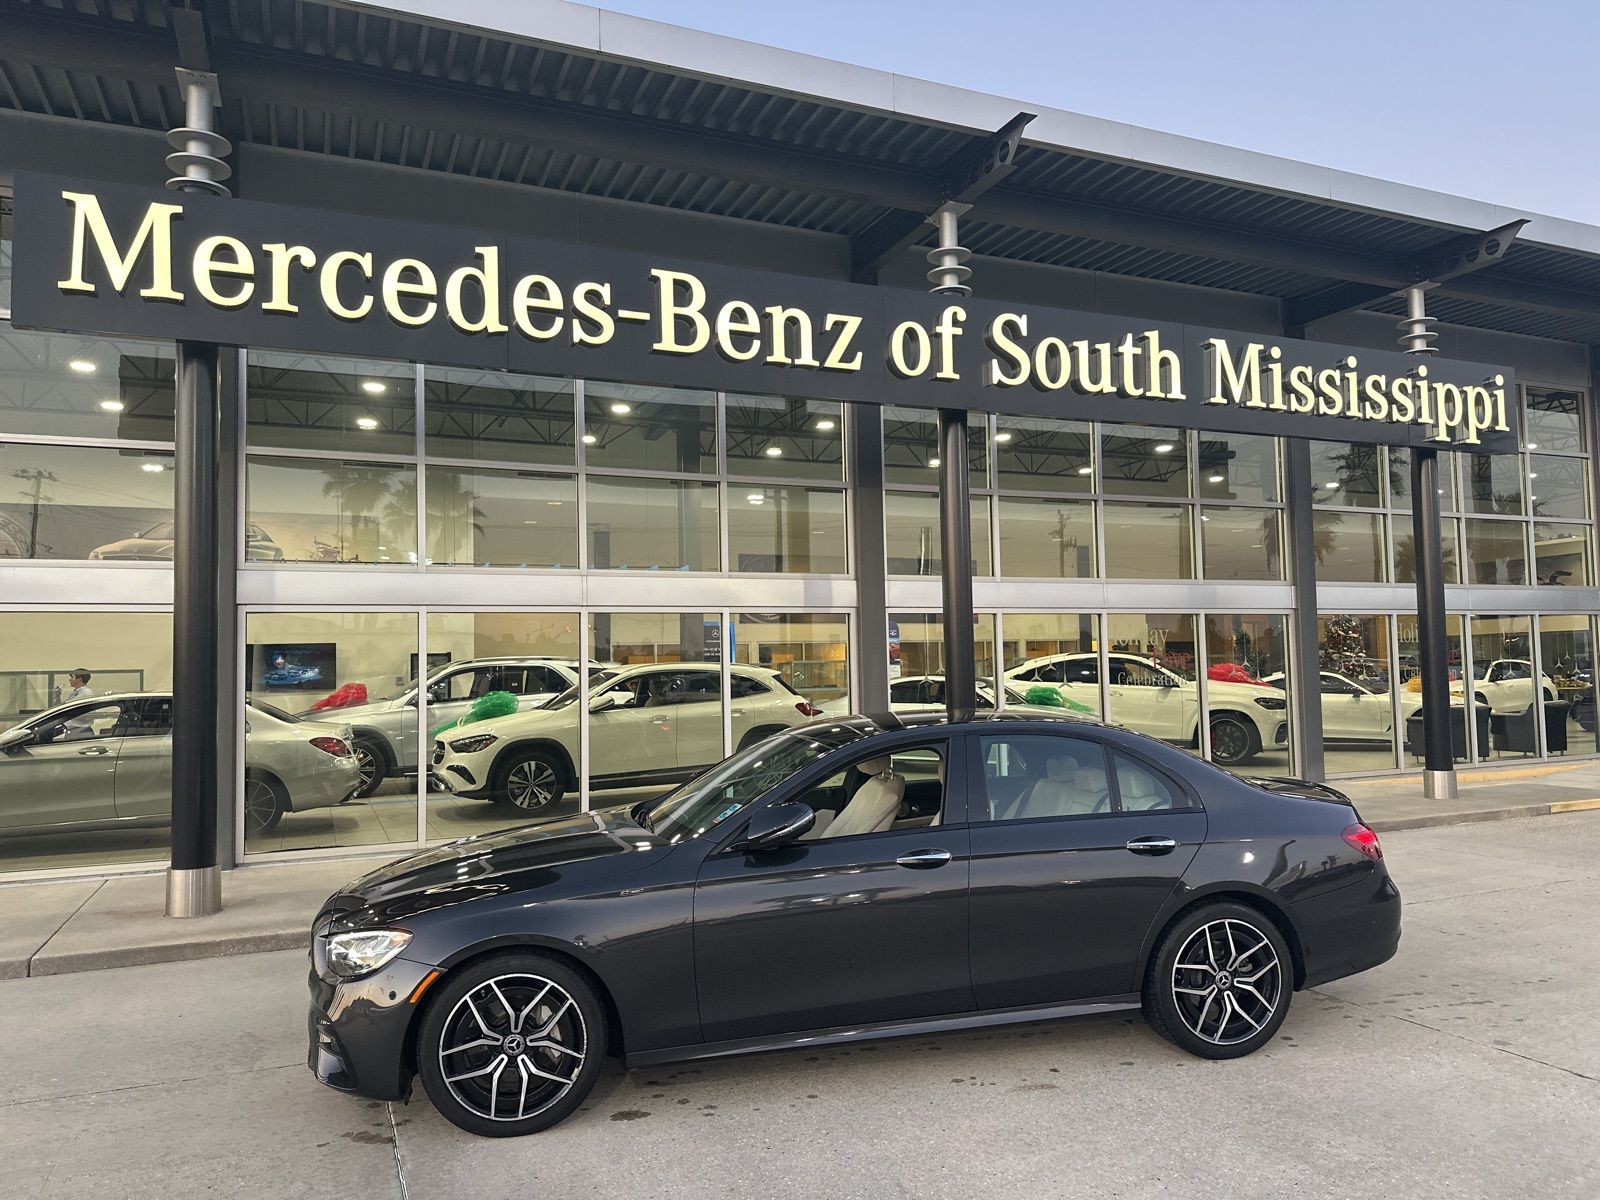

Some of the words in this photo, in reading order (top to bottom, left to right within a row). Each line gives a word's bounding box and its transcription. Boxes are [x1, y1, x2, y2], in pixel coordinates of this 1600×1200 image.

[57, 190, 863, 371] Mercedes-Benz
[890, 305, 967, 380] of
[990, 312, 1187, 400] South
[1208, 337, 1510, 445] Mississippi
